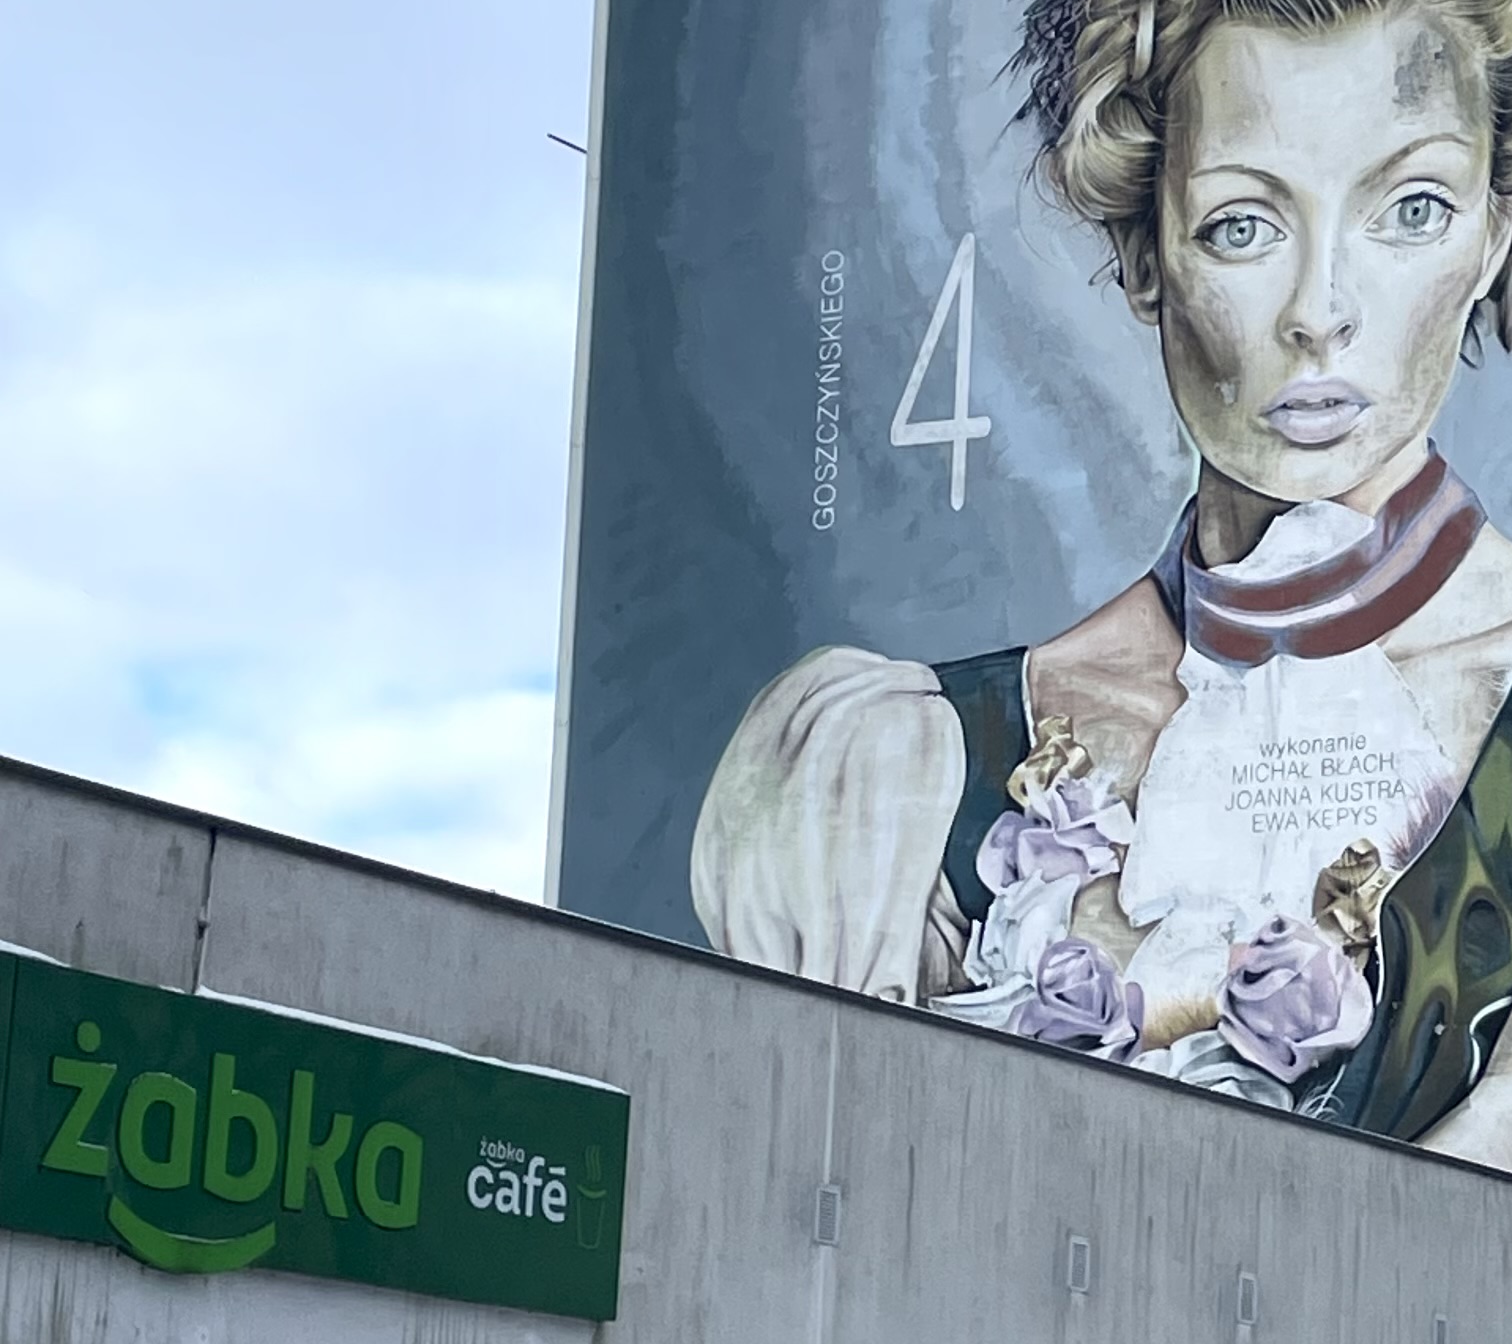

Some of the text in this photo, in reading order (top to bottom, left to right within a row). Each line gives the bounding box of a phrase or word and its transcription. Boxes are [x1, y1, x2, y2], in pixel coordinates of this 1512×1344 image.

[890, 231, 992, 512] 4
[811, 249, 846, 532] GOSZCZYŃSKIEGO
[1259, 733, 1367, 760] wykonanie
[1231, 752, 1395, 785] MICHAŁ BŁACH
[1225, 778, 1407, 812] JOANNA KUSTRA
[1251, 805, 1378, 833] EWA KĘPYS
[39, 1019, 424, 1231] żabka
[478, 1135, 526, 1164] żabka
